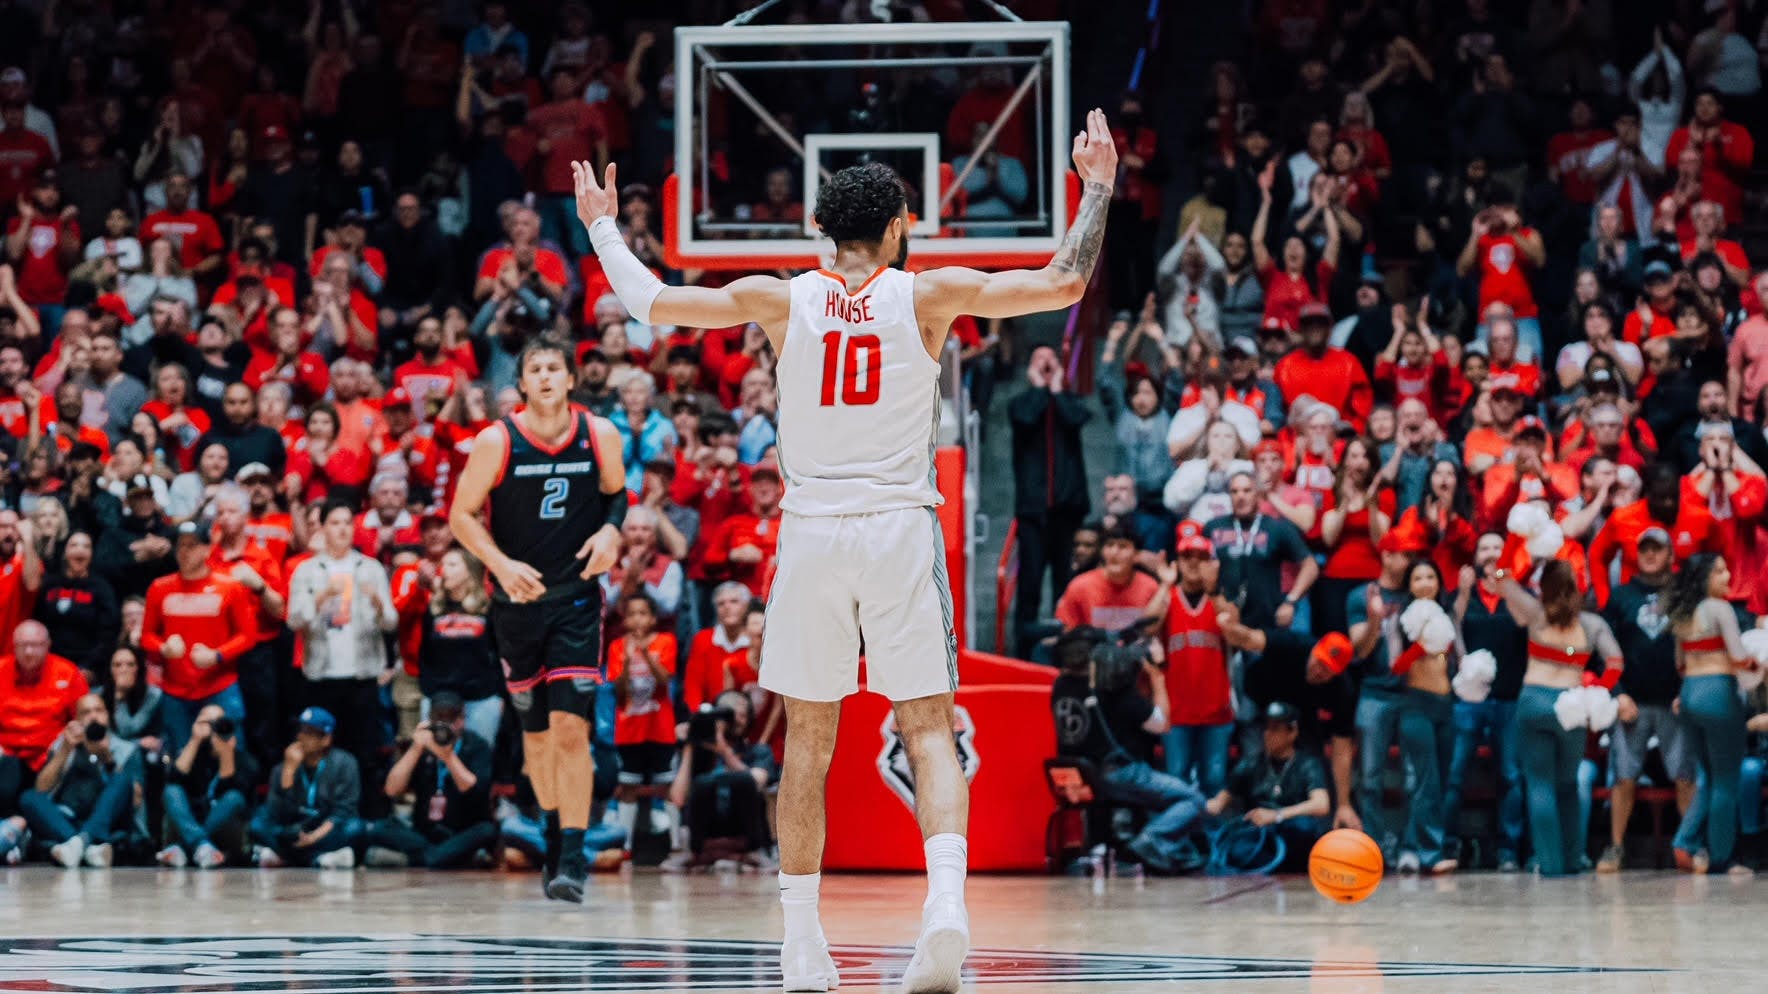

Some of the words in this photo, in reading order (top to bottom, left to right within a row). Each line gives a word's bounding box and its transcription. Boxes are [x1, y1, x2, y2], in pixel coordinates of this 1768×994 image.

[825, 290, 874, 324] HOUSE
[820, 330, 882, 407] 10
[540, 477, 569, 519] 2
